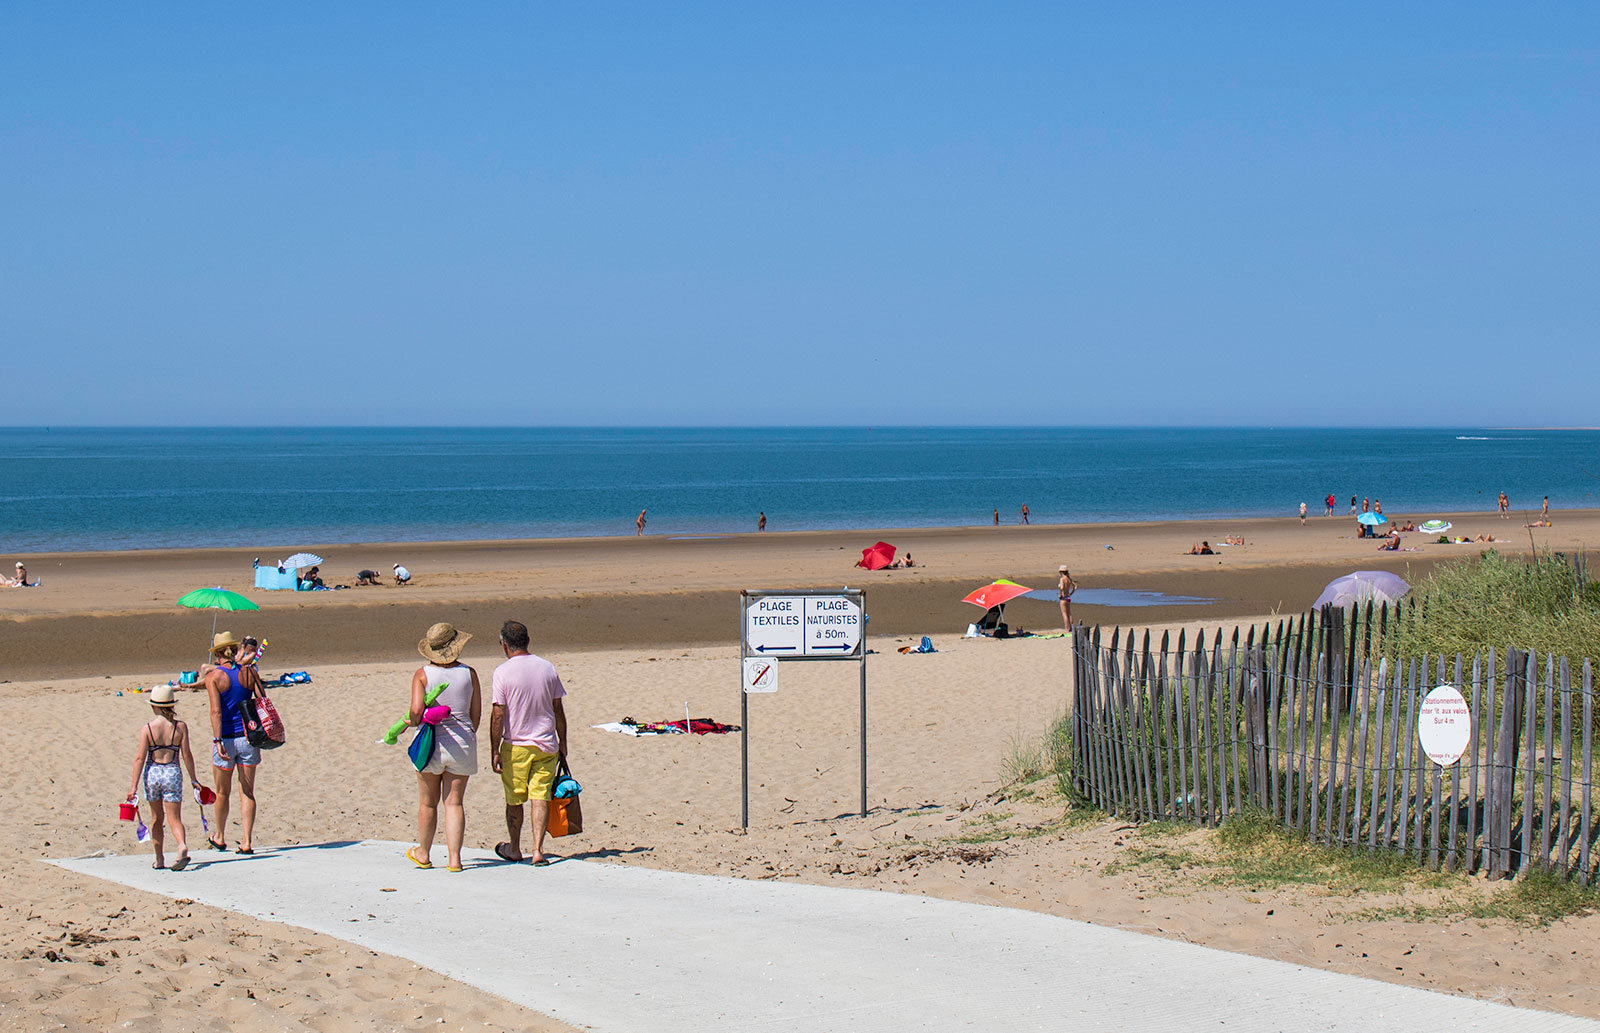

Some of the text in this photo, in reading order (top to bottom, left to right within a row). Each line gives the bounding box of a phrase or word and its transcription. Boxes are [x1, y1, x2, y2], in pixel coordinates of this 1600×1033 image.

[760, 601, 792, 611] PLAGE
[817, 601, 848, 610] PLAGE
[753, 616, 799, 625] TEXTILES
[807, 615, 857, 625] NATURISTES
[825, 629, 849, 639] 50m.
